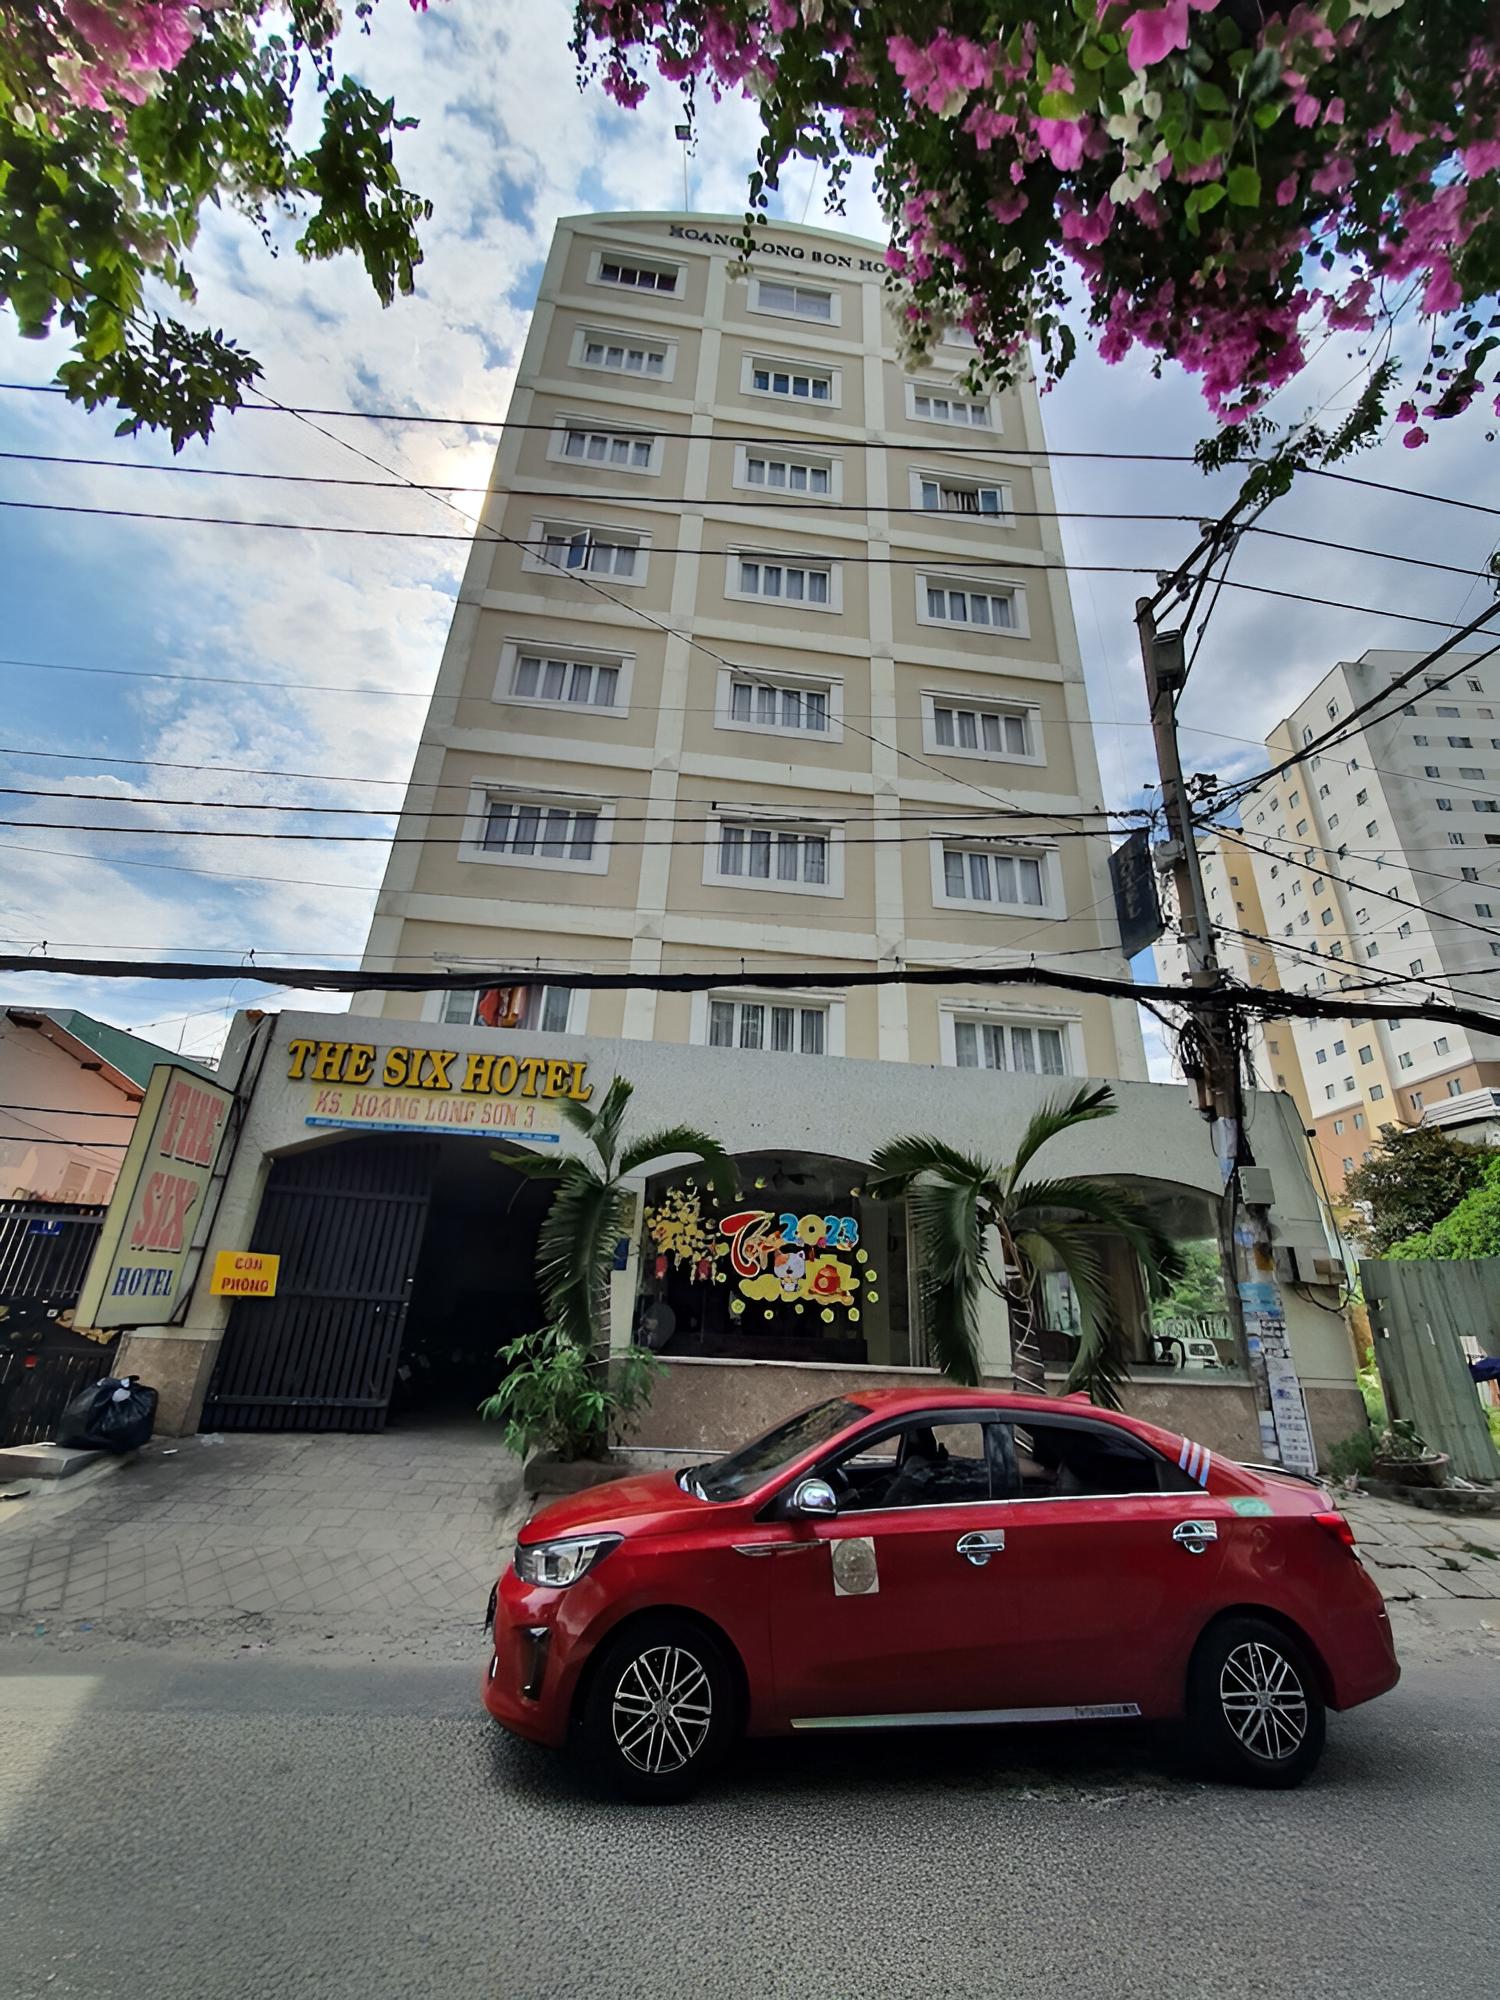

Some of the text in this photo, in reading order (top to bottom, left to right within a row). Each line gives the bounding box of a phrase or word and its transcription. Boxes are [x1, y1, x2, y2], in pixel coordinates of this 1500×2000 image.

[812, 251, 852, 267] BON
[287, 1038, 594, 1101] THE SIX HOTEL
[160, 1080, 225, 1168] THE
[425, 1098, 477, 1123] LONG
[523, 1105, 536, 1128] 3
[130, 1171, 199, 1253] SIX
[779, 1212, 859, 1251] 2023
[111, 1266, 174, 1297] HOTEL
